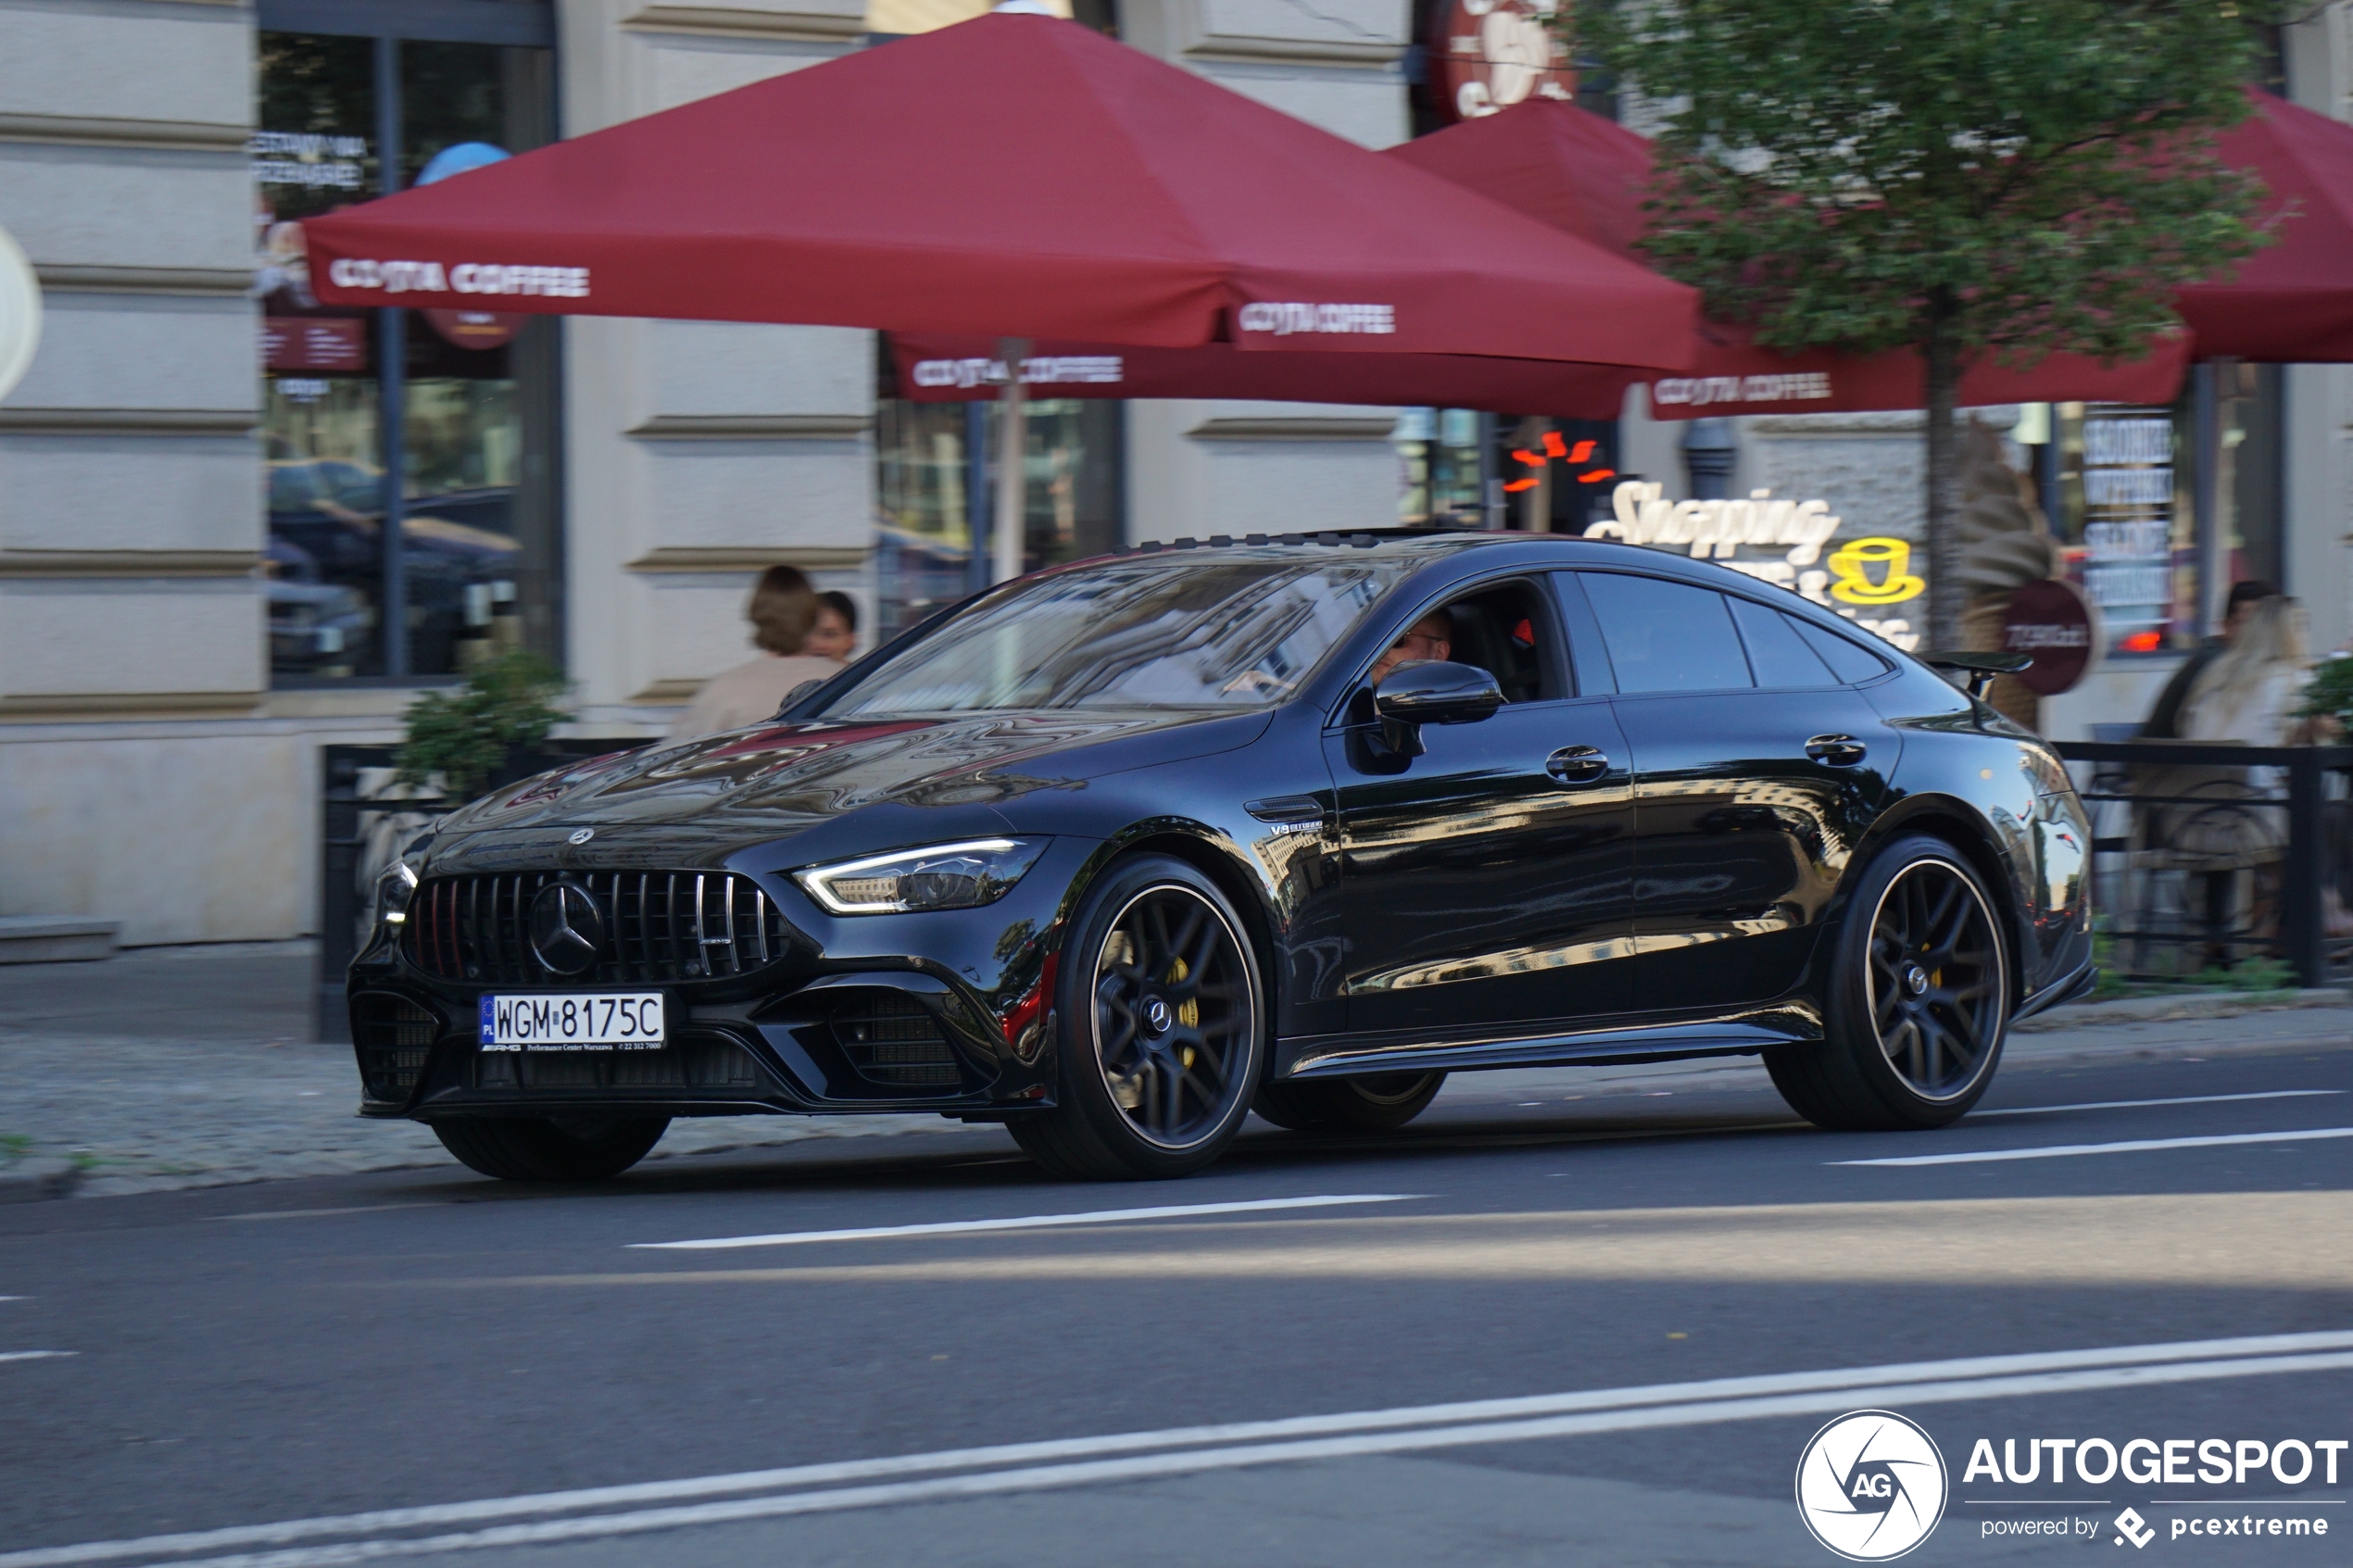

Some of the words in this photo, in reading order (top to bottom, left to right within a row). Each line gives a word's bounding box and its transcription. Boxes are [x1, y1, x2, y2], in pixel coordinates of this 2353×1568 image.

[330, 258, 448, 293] COSTA
[449, 263, 590, 297] COFFEE
[1239, 302, 1316, 335] COSTA
[1315, 304, 1395, 333] COFFEE
[1654, 376, 1742, 406] COSTA
[1743, 372, 1832, 402] COFFEE
[1270, 824, 1290, 835] V8
[483, 1024, 494, 1035] PL
[497, 999, 550, 1038] WGM
[561, 997, 660, 1037] 8175C
